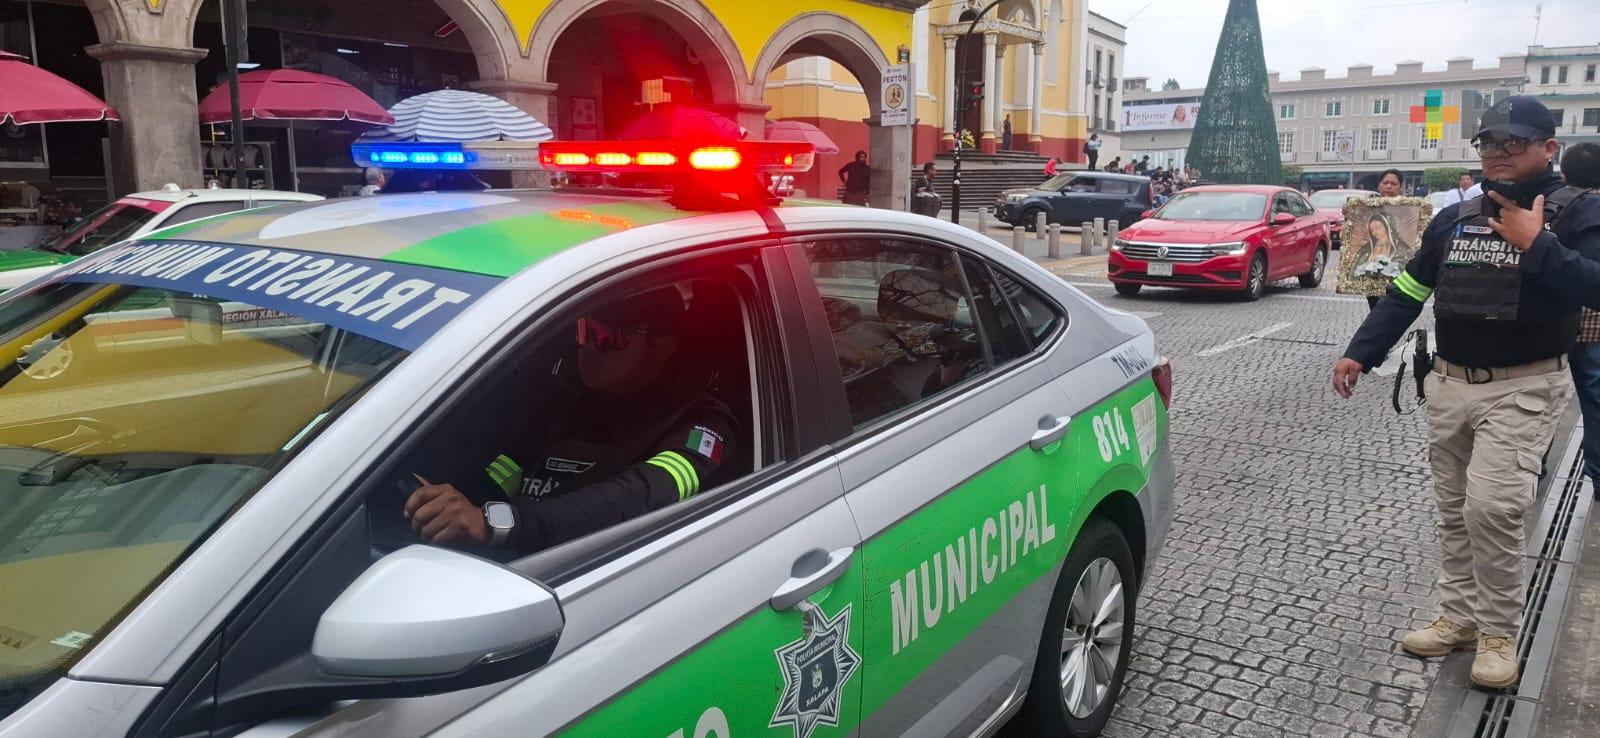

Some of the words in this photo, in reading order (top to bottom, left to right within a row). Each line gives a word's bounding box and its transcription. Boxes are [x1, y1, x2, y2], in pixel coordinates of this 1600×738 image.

[1092, 407, 1130, 462] 814
[889, 483, 1056, 657] MUNICIPAL
[806, 686, 829, 707] XALAPA
